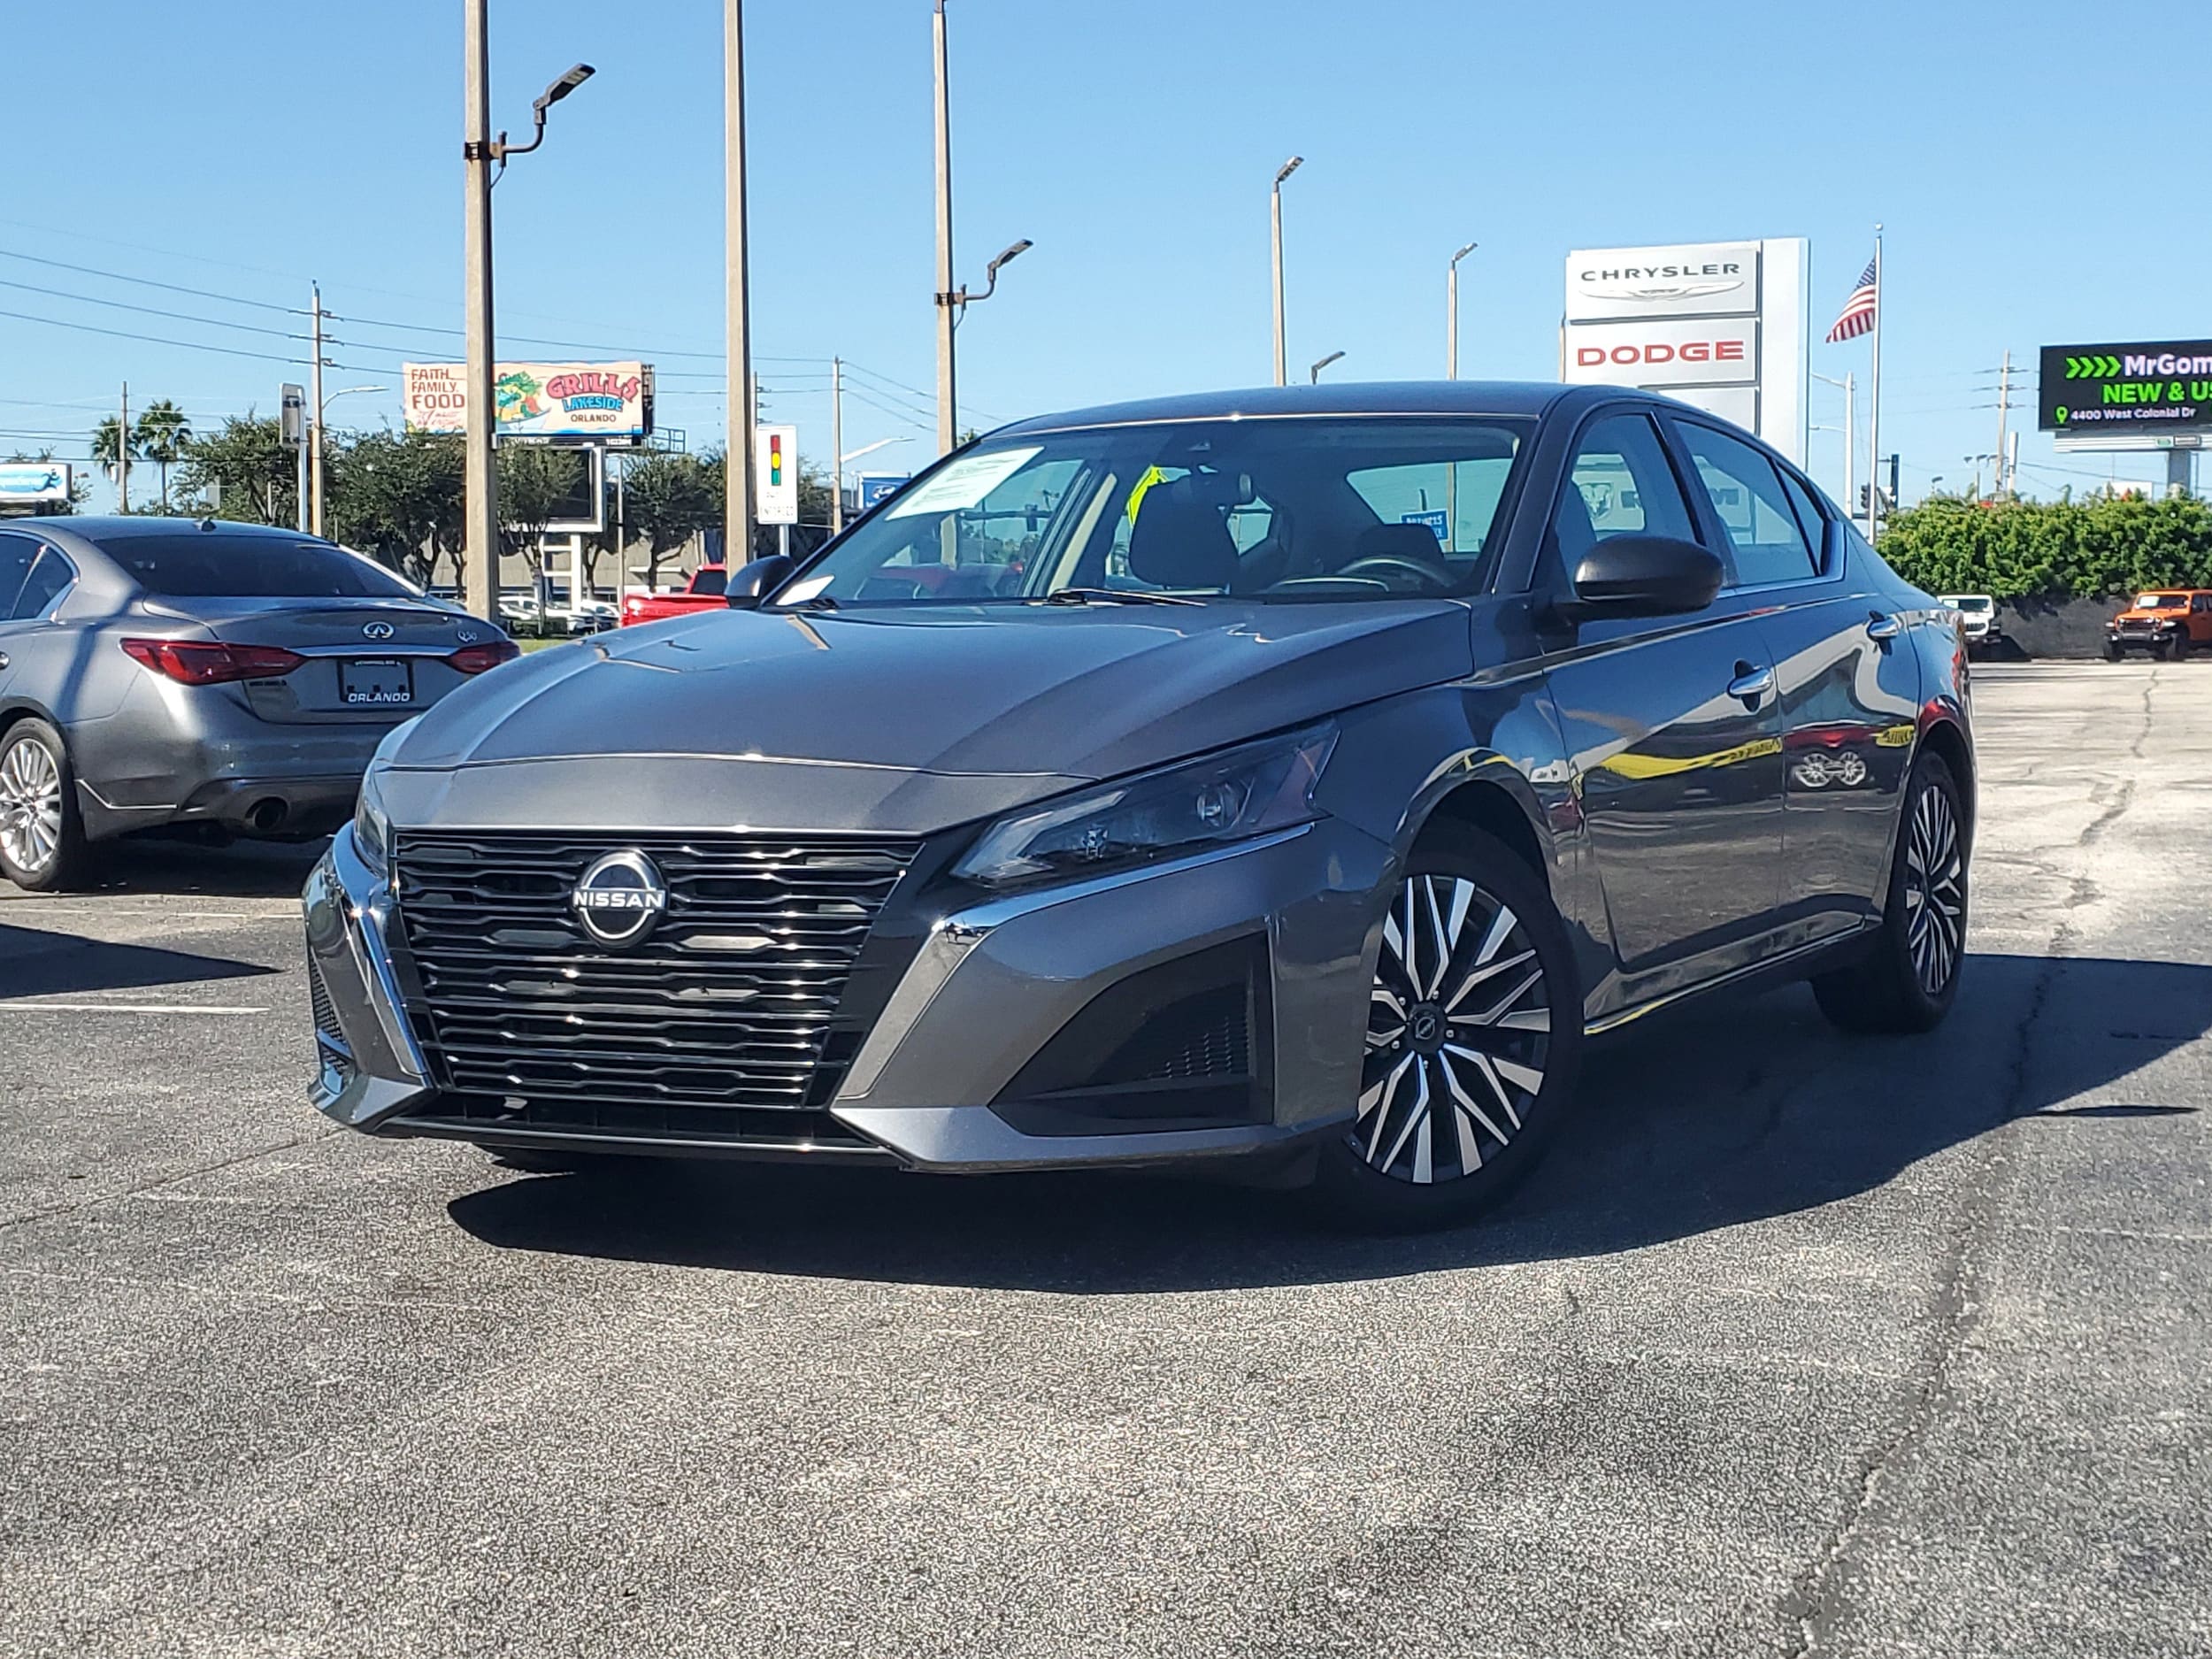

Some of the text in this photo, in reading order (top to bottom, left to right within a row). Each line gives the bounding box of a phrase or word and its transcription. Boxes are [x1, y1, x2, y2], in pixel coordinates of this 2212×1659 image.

[1581, 264, 1740, 281] CHRYSLER
[1578, 341, 1744, 366] DODGE
[546, 373, 641, 403] GRILLS
[2102, 382, 2162, 403] NEW
[2168, 381, 2185, 401] &
[412, 394, 465, 410] FOOD
[562, 396, 625, 412] LAKESIDE
[571, 413, 617, 423] ORLANDO
[2071, 407, 2196, 420] 4400 West Colonial Dr
[348, 692, 411, 703] ORLANDO
[573, 891, 663, 908] NISSAN
